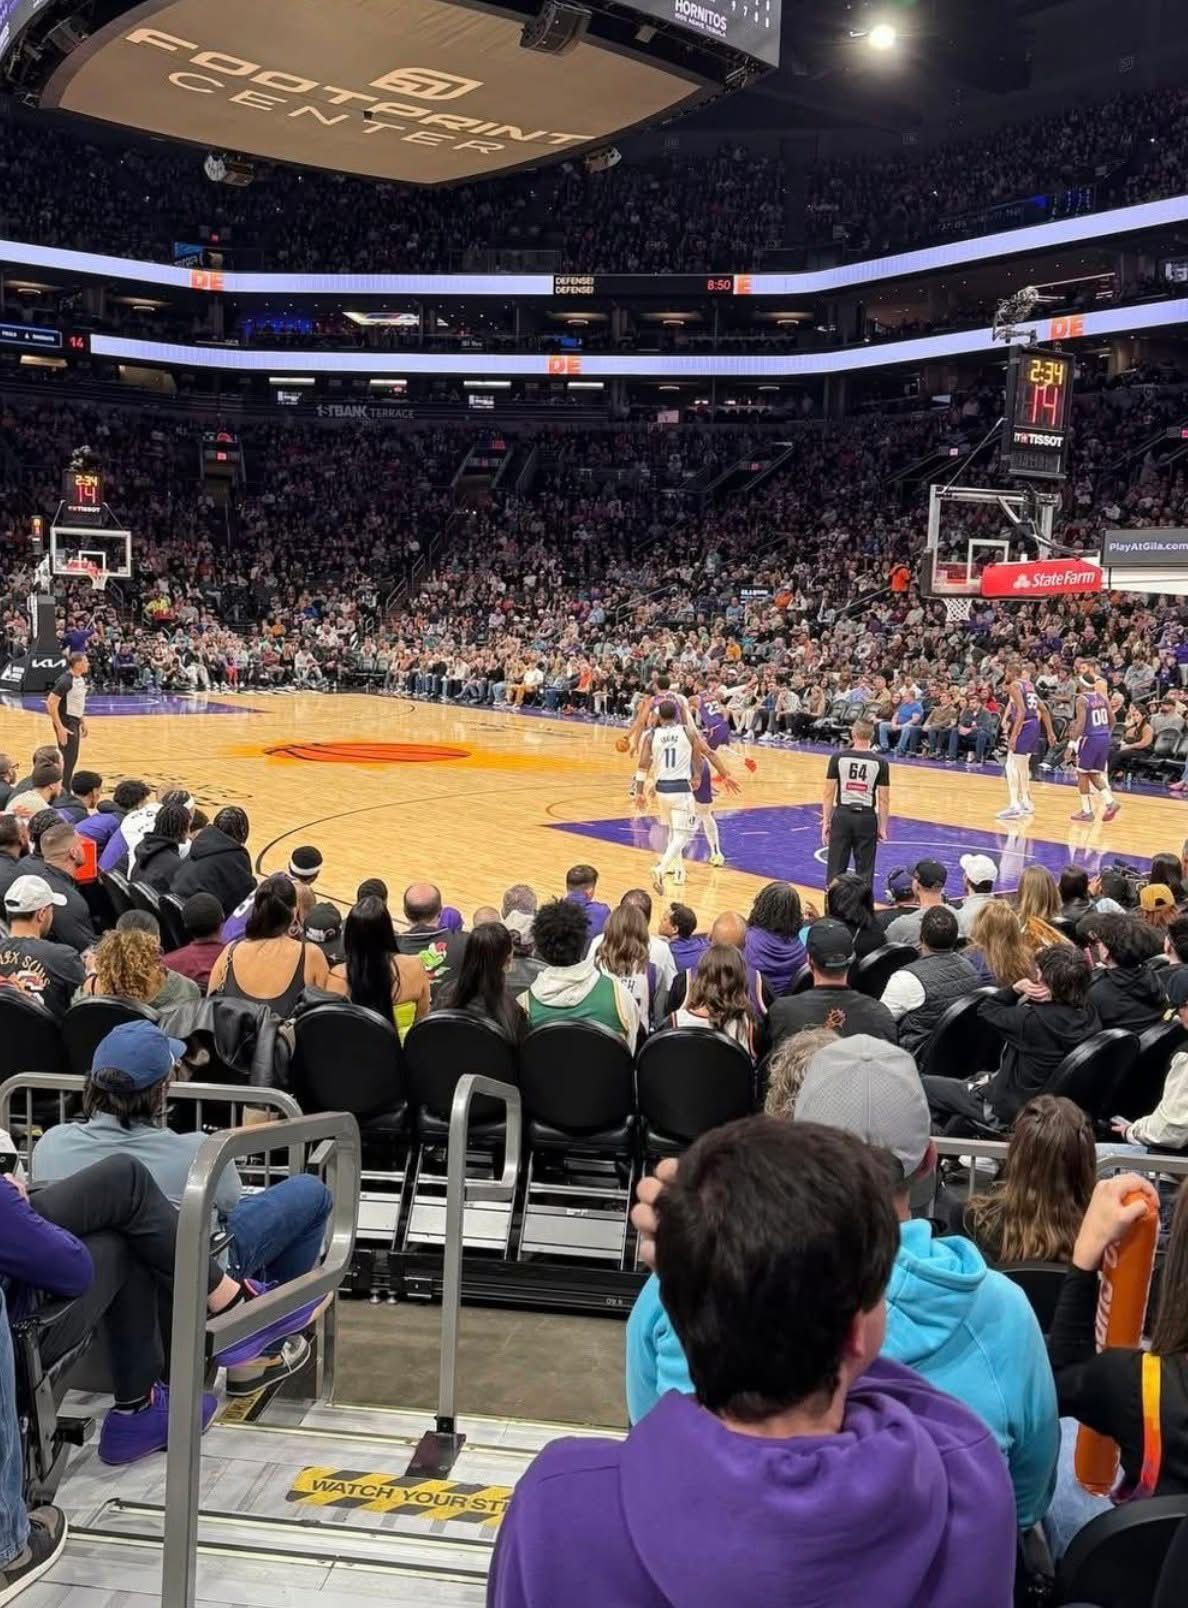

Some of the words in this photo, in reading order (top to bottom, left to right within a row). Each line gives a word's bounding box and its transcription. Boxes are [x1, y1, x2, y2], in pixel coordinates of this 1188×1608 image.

[675, 0, 727, 31] HORNITOS
[125, 28, 597, 144] FOOTPRINT
[168, 72, 505, 154] CENTER
[707, 279, 731, 290] 8:50
[1030, 359, 1064, 385] 2:34
[1032, 383, 1059, 426] 14
[1029, 433, 1063, 447] TISSOT
[1091, 708, 1108, 727] 00
[664, 747, 676, 768] 11
[849, 762, 868, 781] 64
[311, 1479, 394, 1499] WATCH
[402, 1490, 471, 1508] YOUR
